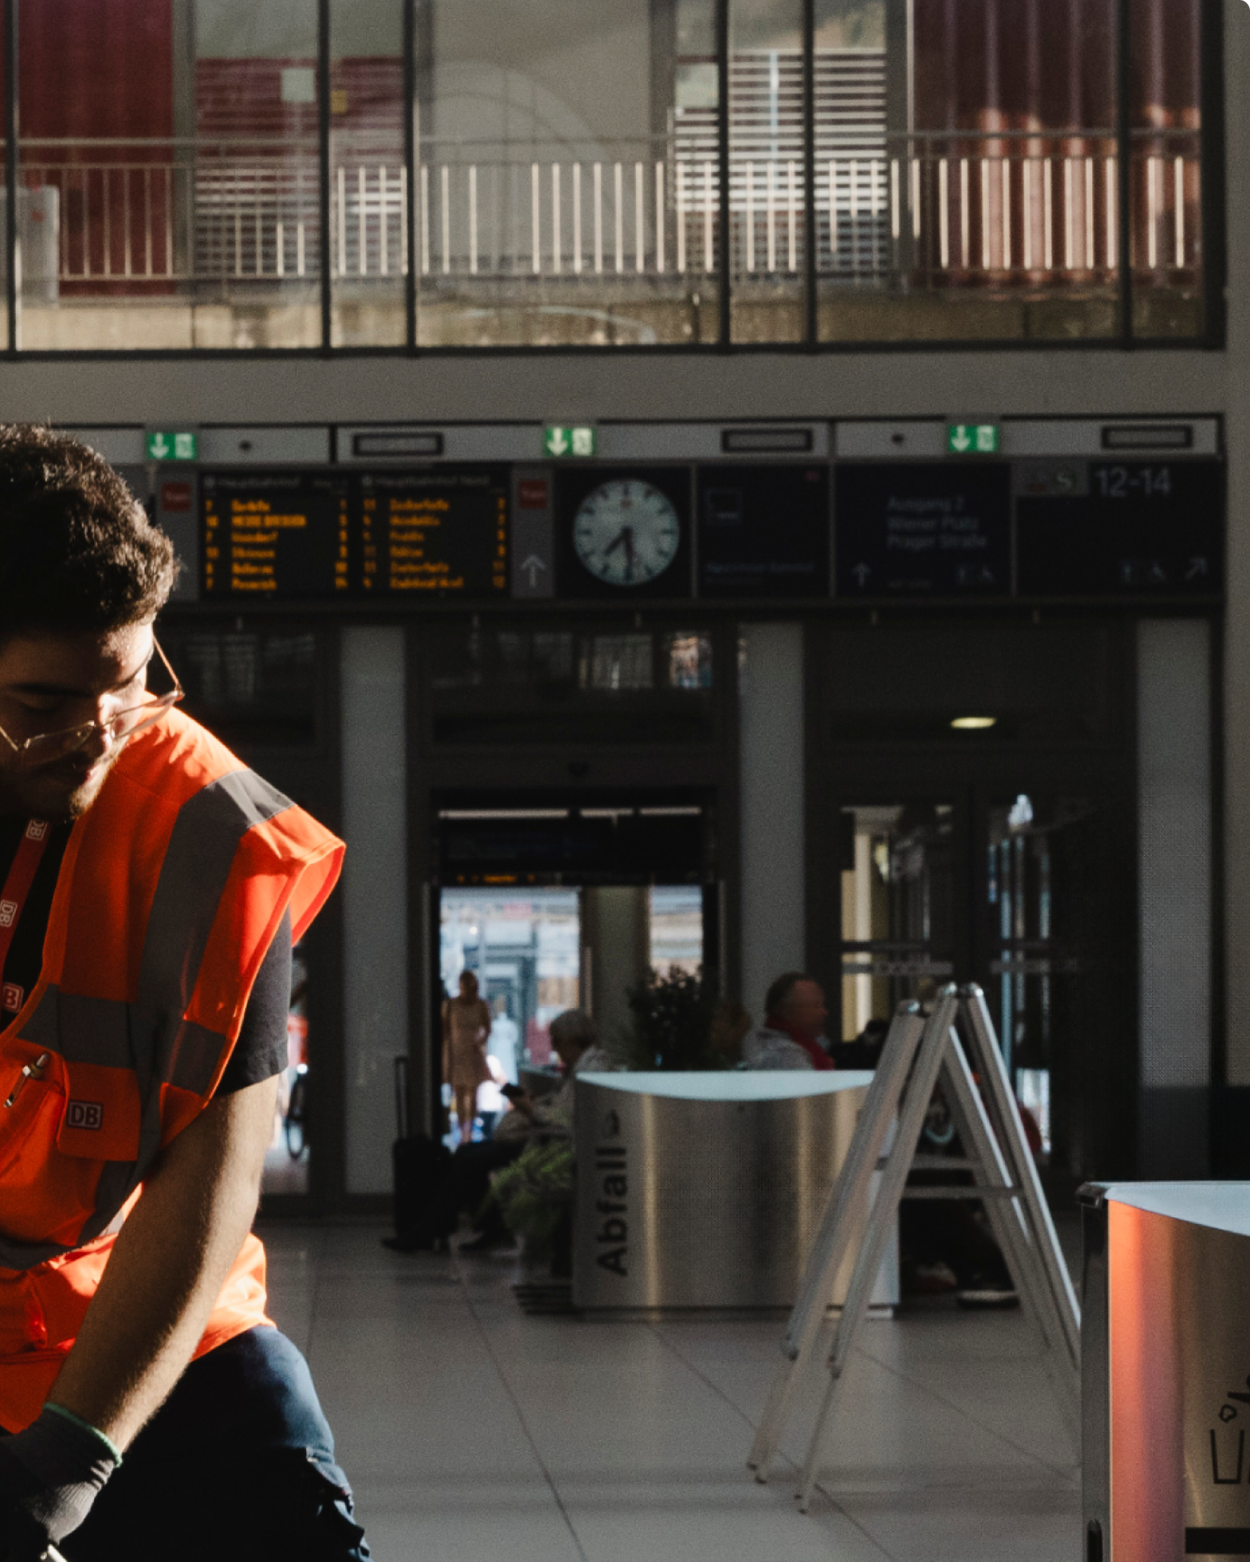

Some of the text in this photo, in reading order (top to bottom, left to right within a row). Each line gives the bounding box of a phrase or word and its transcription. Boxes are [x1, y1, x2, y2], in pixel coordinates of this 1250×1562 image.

[1095, 466, 1173, 498] 12-14
[70, 1103, 100, 1126] DB
[596, 1145, 629, 1277] Abfall
